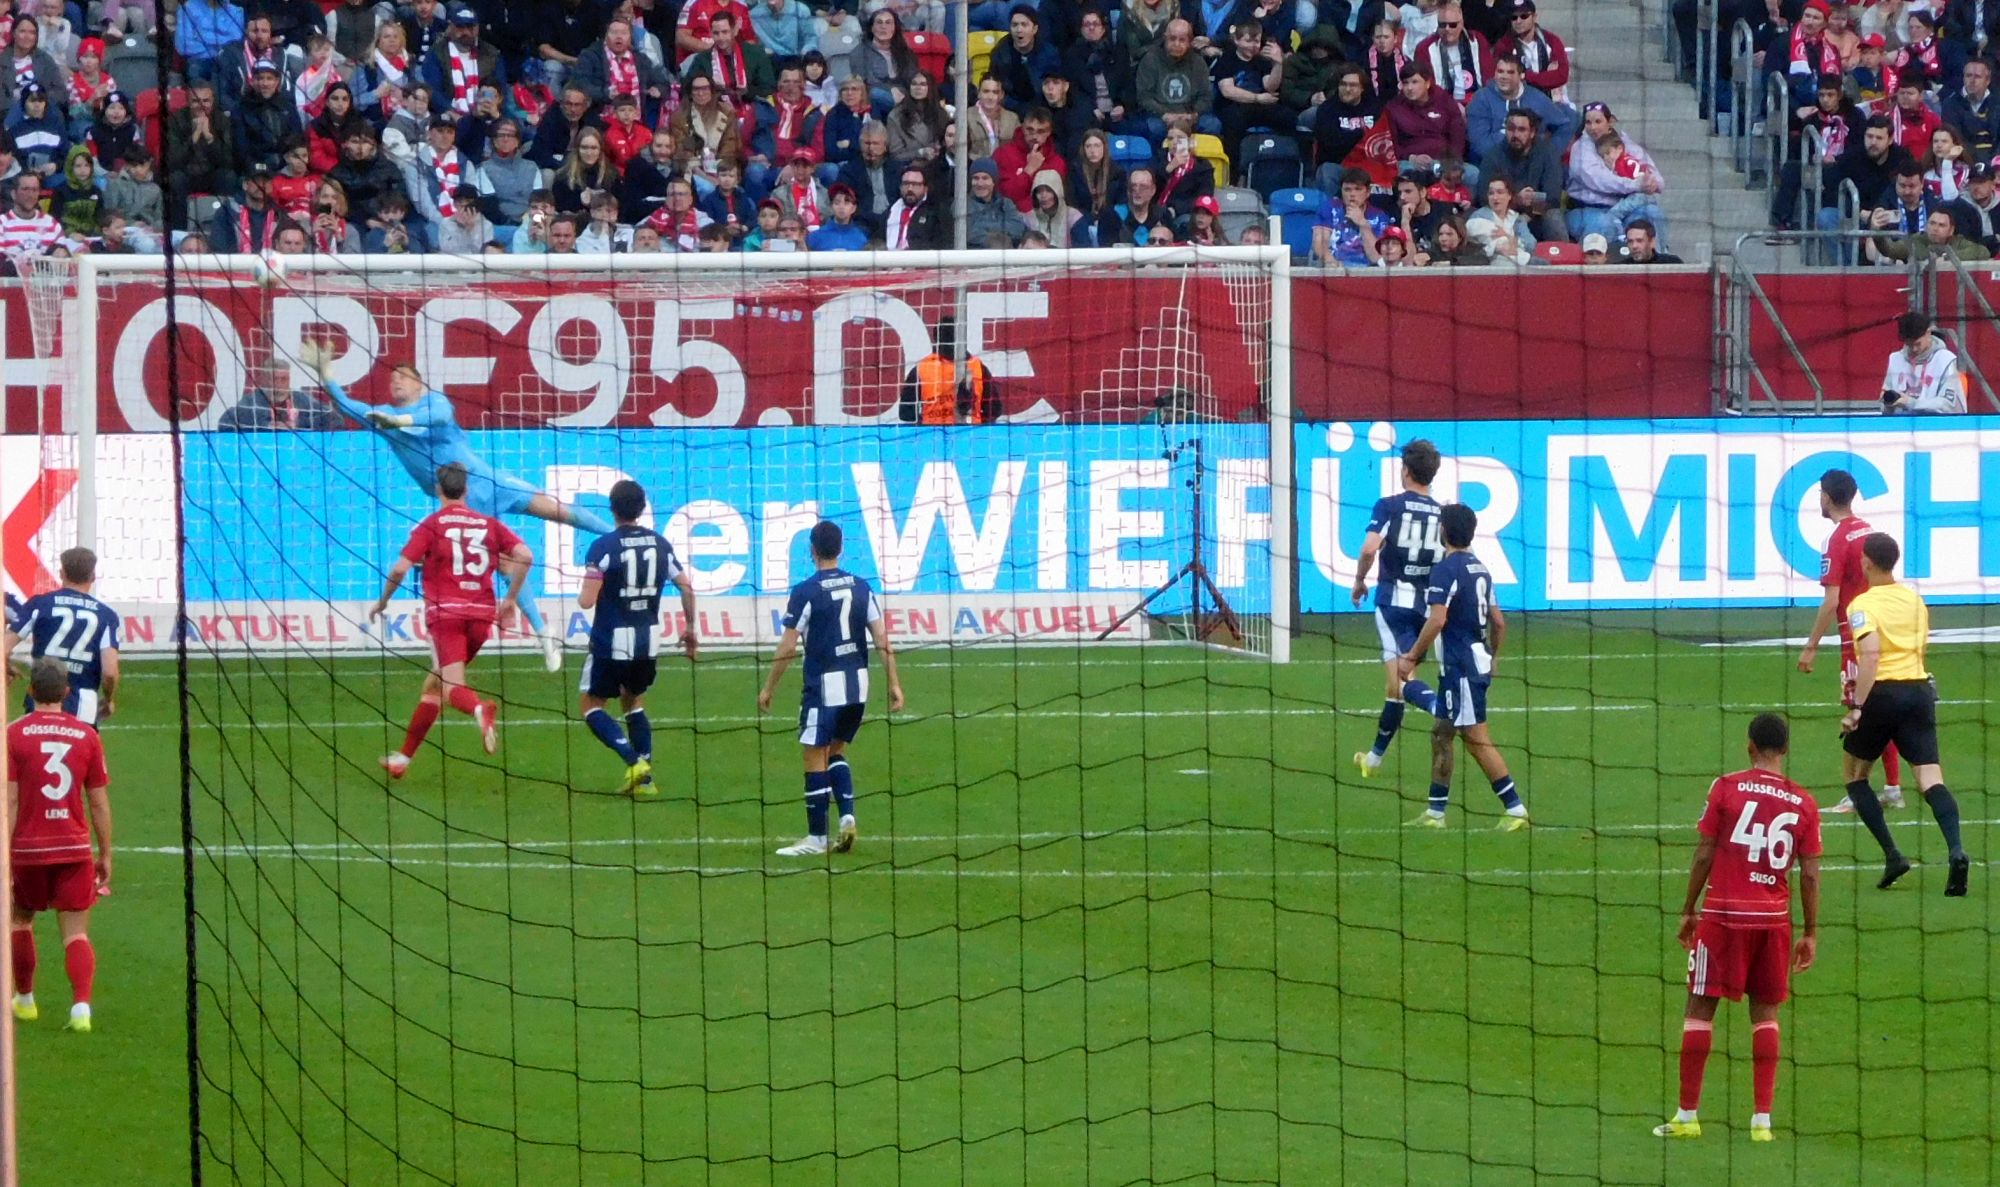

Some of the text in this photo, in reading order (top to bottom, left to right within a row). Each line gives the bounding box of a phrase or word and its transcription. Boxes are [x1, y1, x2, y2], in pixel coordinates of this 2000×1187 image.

[544, 421, 2000, 595] Der WIE FÜR MICH
[445, 527, 490, 576] 13
[1397, 512, 1446, 564] 44
[620, 547, 657, 597] 11
[44, 607, 99, 662] 22
[169, 614, 349, 643] AKTUELL
[952, 605, 1132, 636] AKTUELL
[831, 588, 853, 641] 7
[41, 741, 73, 800] 3
[1737, 781, 1803, 806] DÜSSELDORF
[45, 808, 69, 819] LENZ
[1730, 800, 1799, 870] 46
[1749, 871, 1777, 885] SUSO
